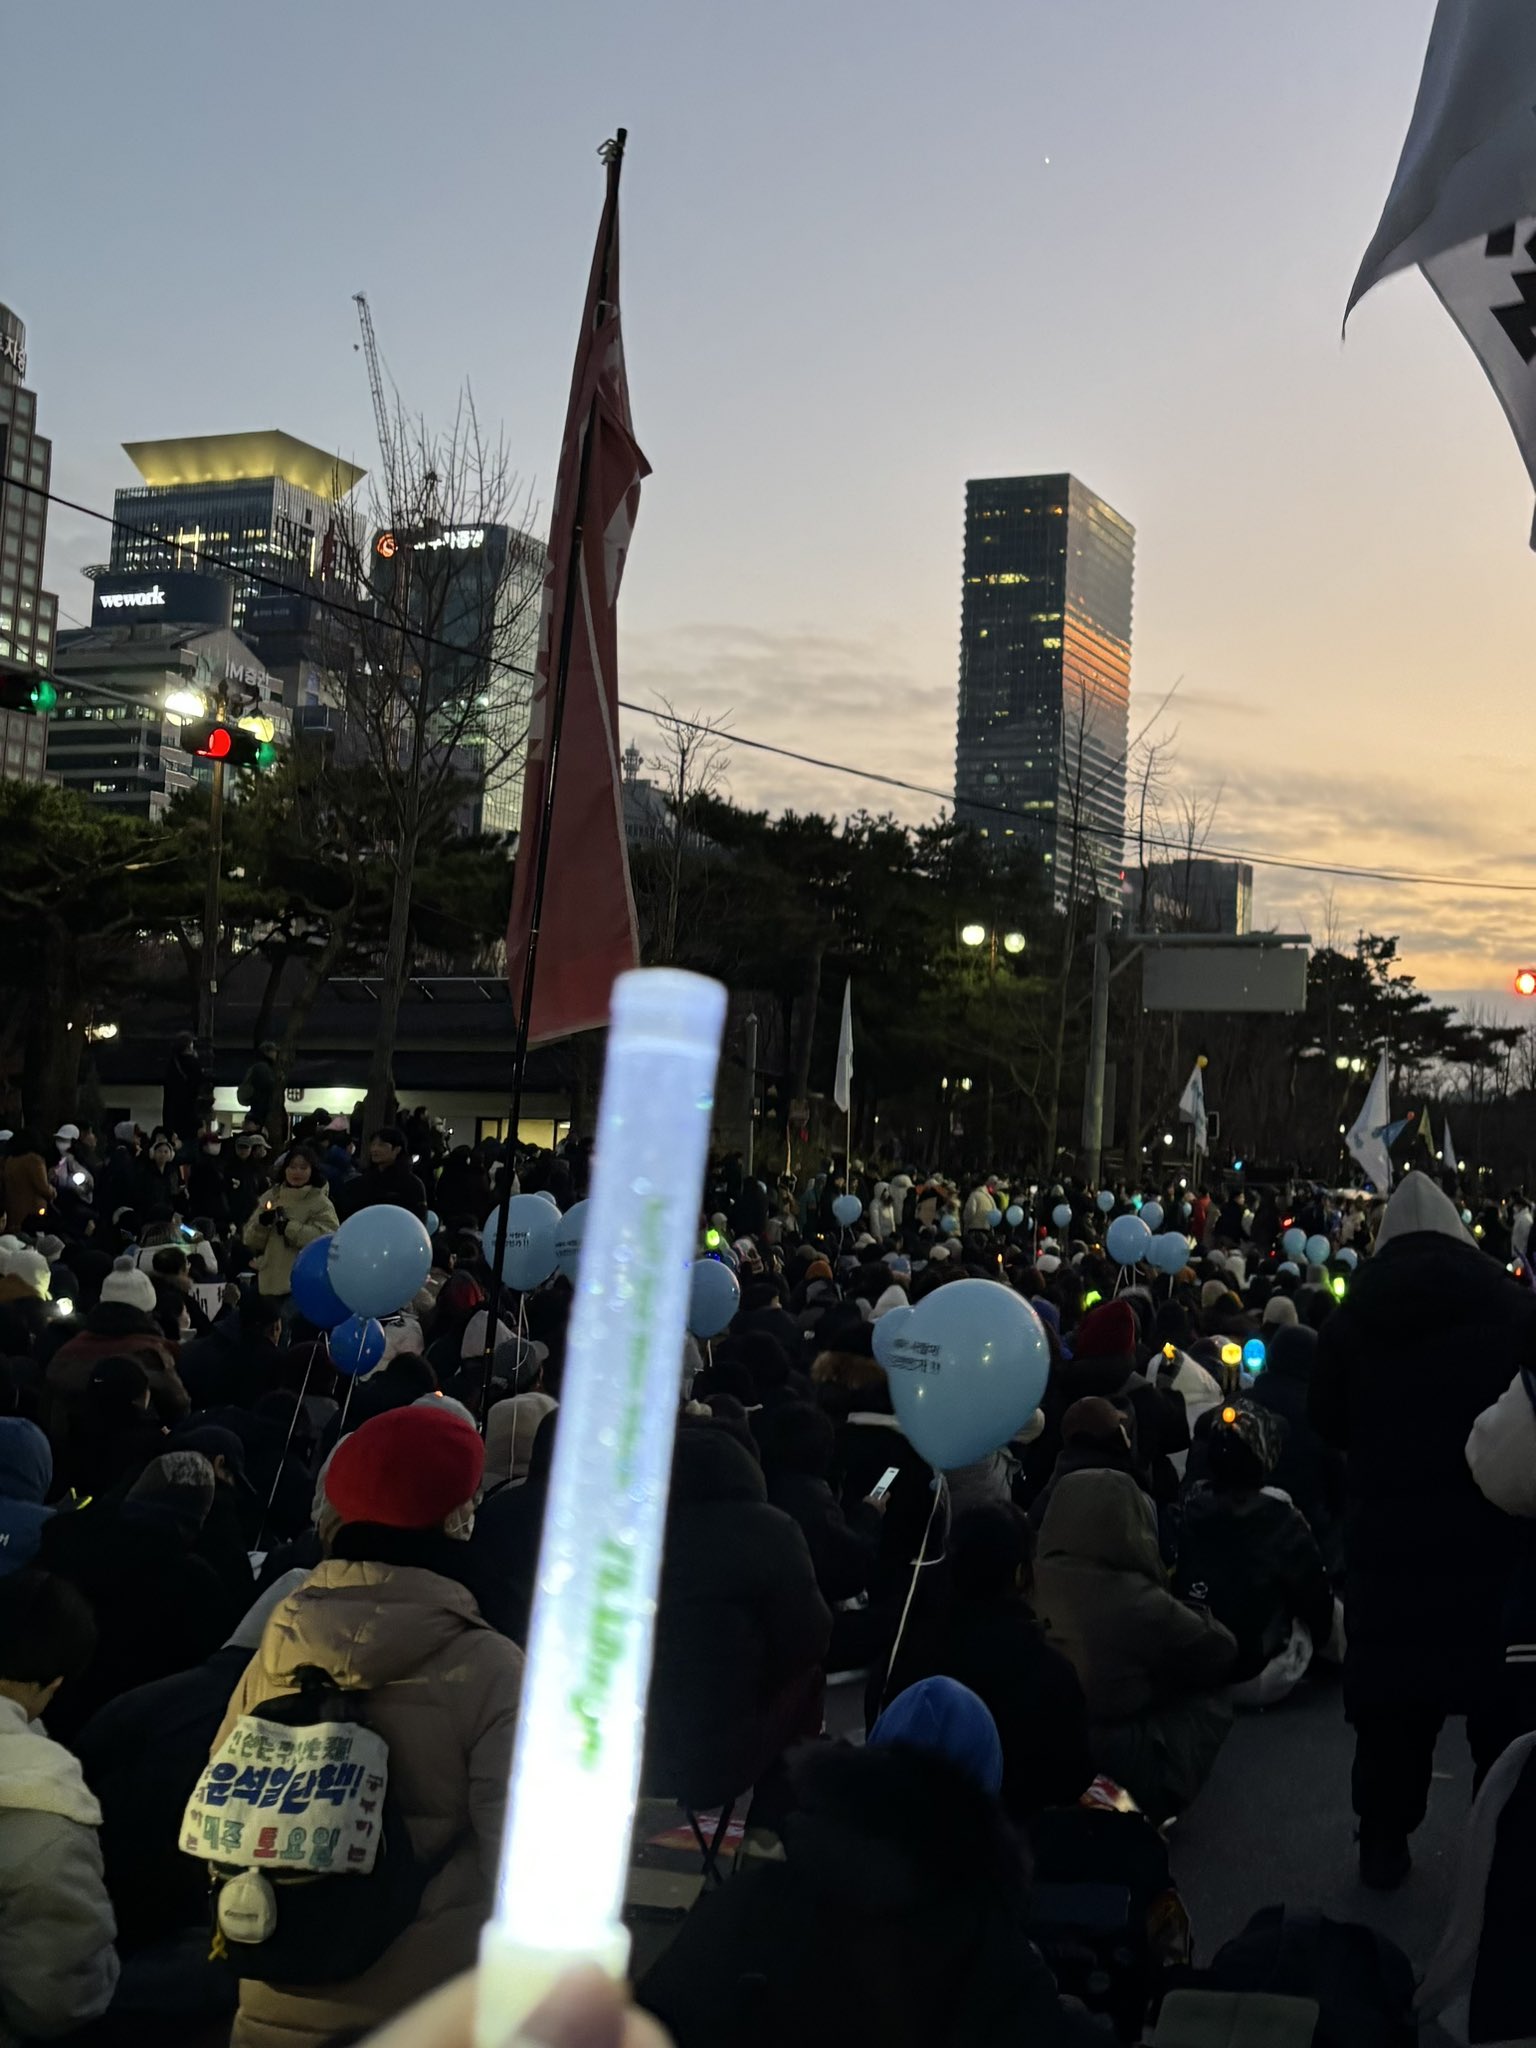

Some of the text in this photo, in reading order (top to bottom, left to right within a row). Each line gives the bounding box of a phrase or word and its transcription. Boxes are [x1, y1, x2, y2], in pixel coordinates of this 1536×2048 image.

[100, 585, 166, 608] wework
[205, 1762, 366, 1815] 윤석열탄핵!
[253, 1826, 341, 1867] 토요일
